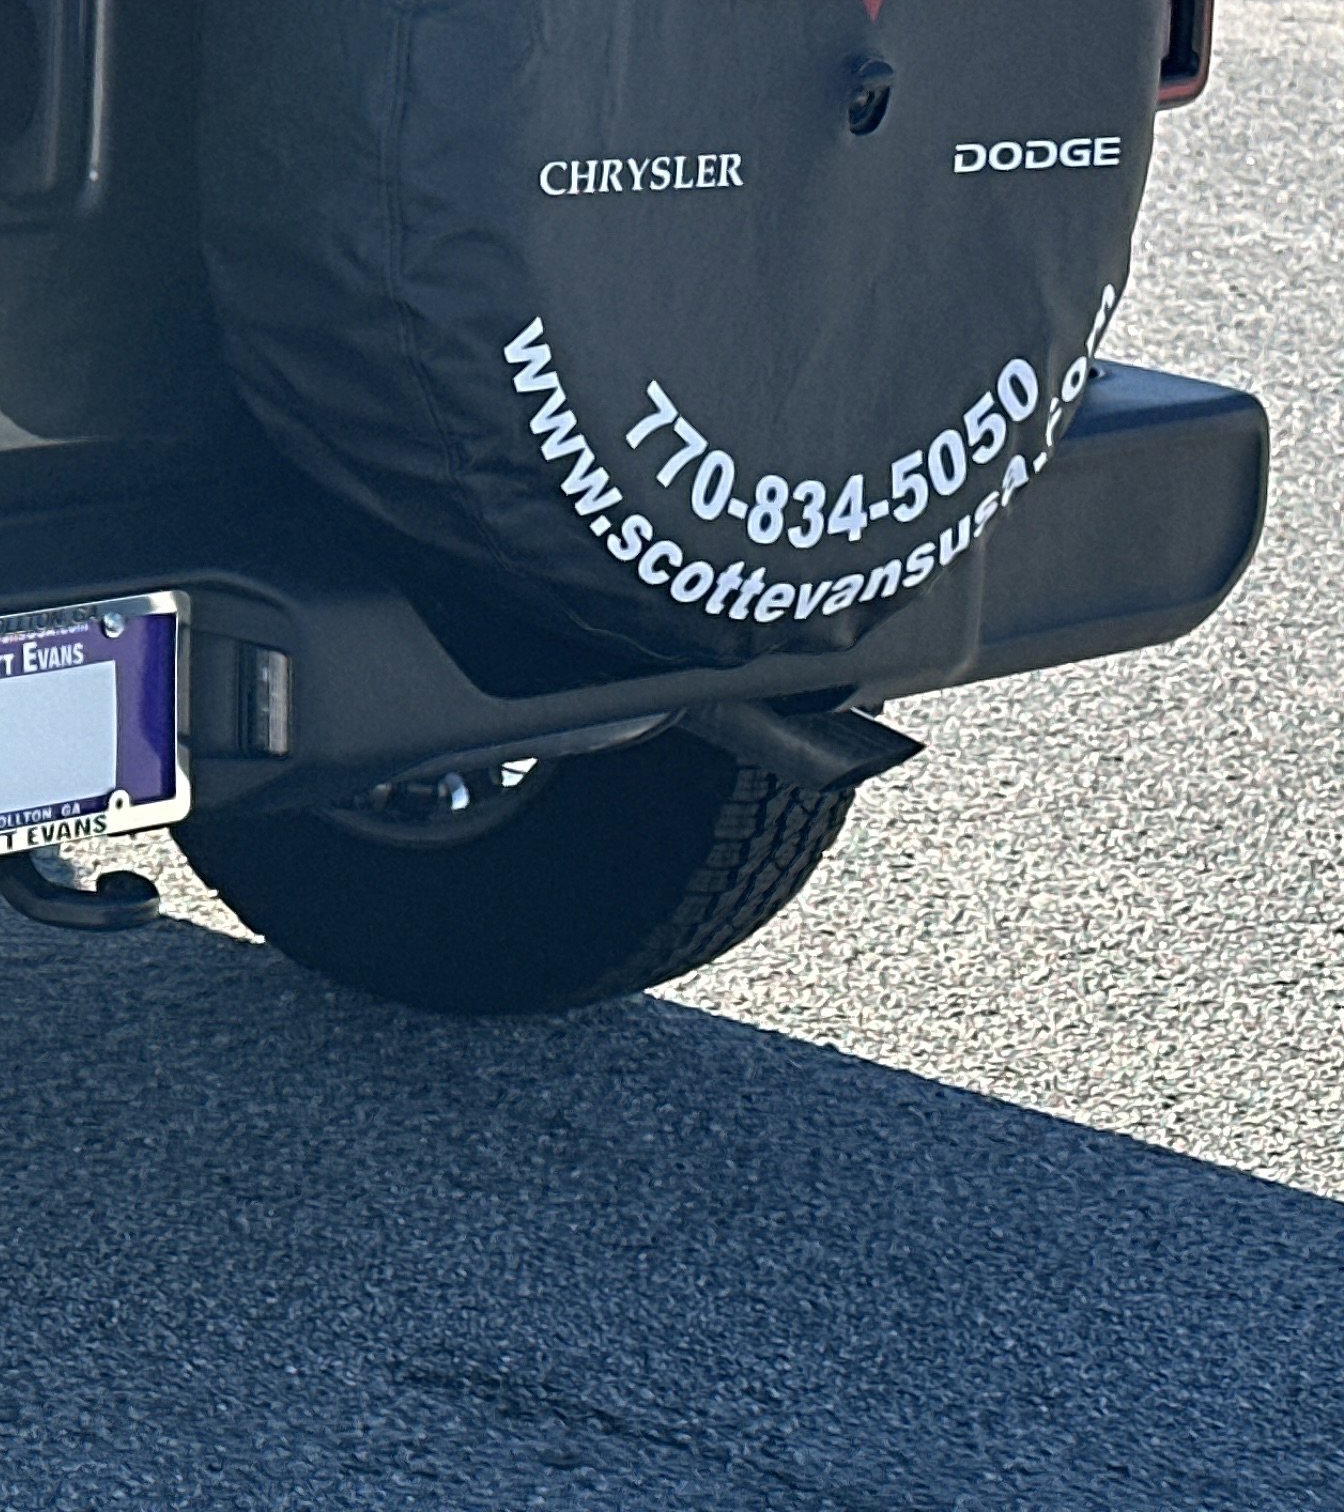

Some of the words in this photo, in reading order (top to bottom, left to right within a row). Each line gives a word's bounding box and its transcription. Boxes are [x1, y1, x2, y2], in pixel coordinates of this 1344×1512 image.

[953, 136, 1121, 173] DODGE
[539, 153, 744, 196] CHRYSLER
[625, 358, 1040, 549] 770-834-5050
[61, 802, 81, 817] GA
[27, 814, 108, 846] EVANS
